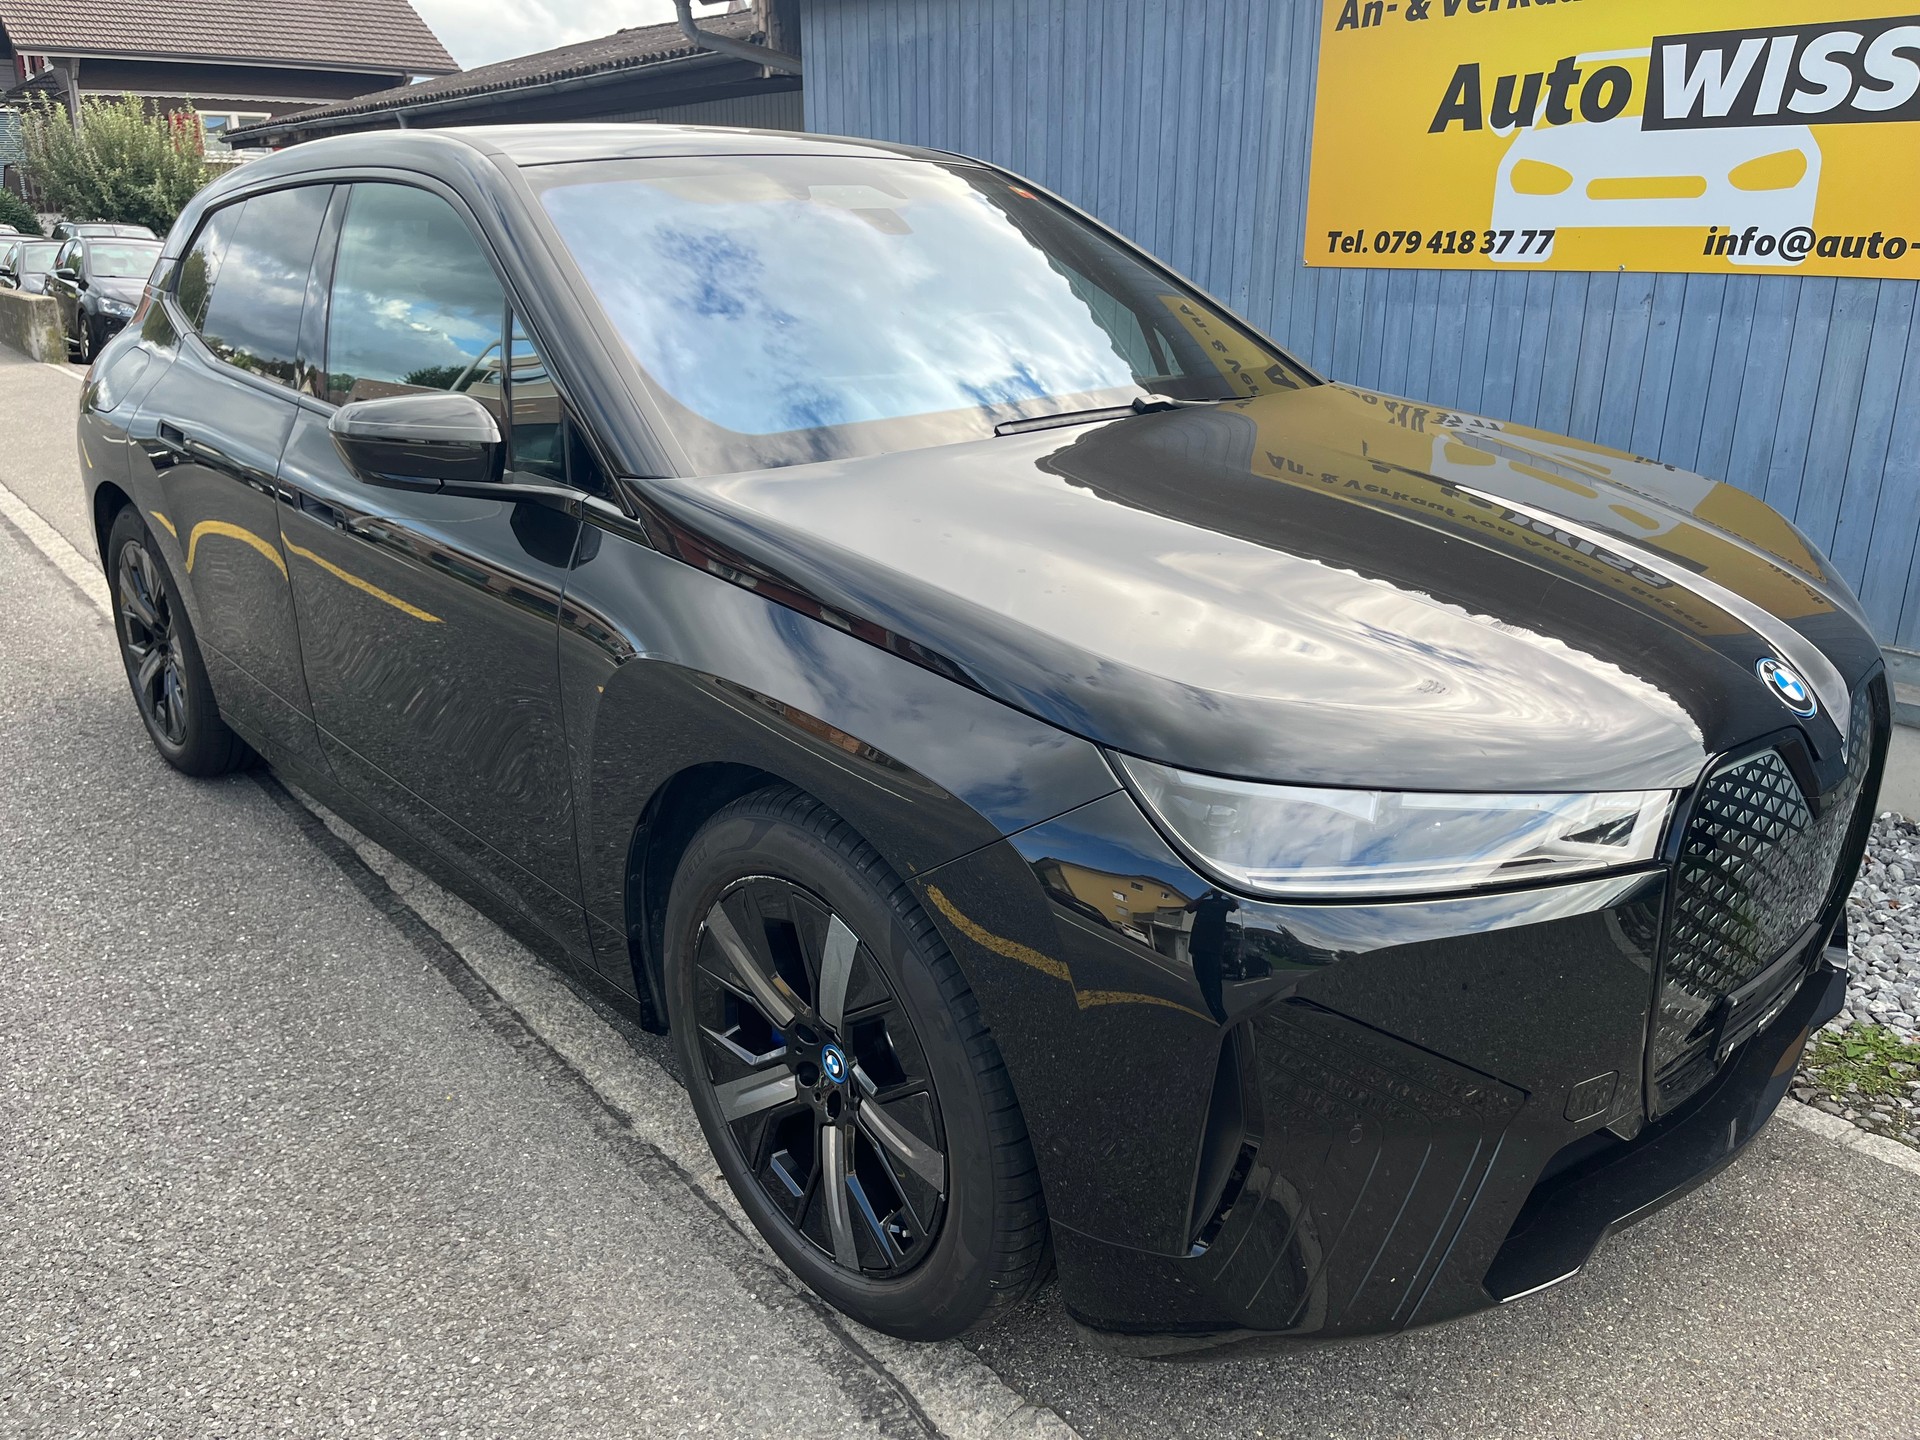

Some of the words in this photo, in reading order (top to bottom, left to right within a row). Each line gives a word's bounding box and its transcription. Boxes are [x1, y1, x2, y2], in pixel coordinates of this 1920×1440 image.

[1335, 0, 1397, 31] An-
[1427, 55, 1633, 134] Auto
[1661, 25, 1920, 119] WISS
[1327, 229, 1369, 254] Tel.
[1373, 229, 1422, 254] 079
[1426, 229, 1476, 255] 418
[1479, 229, 1515, 255] 37
[1517, 229, 1556, 255] 77
[1702, 225, 1920, 262] info@auto-
